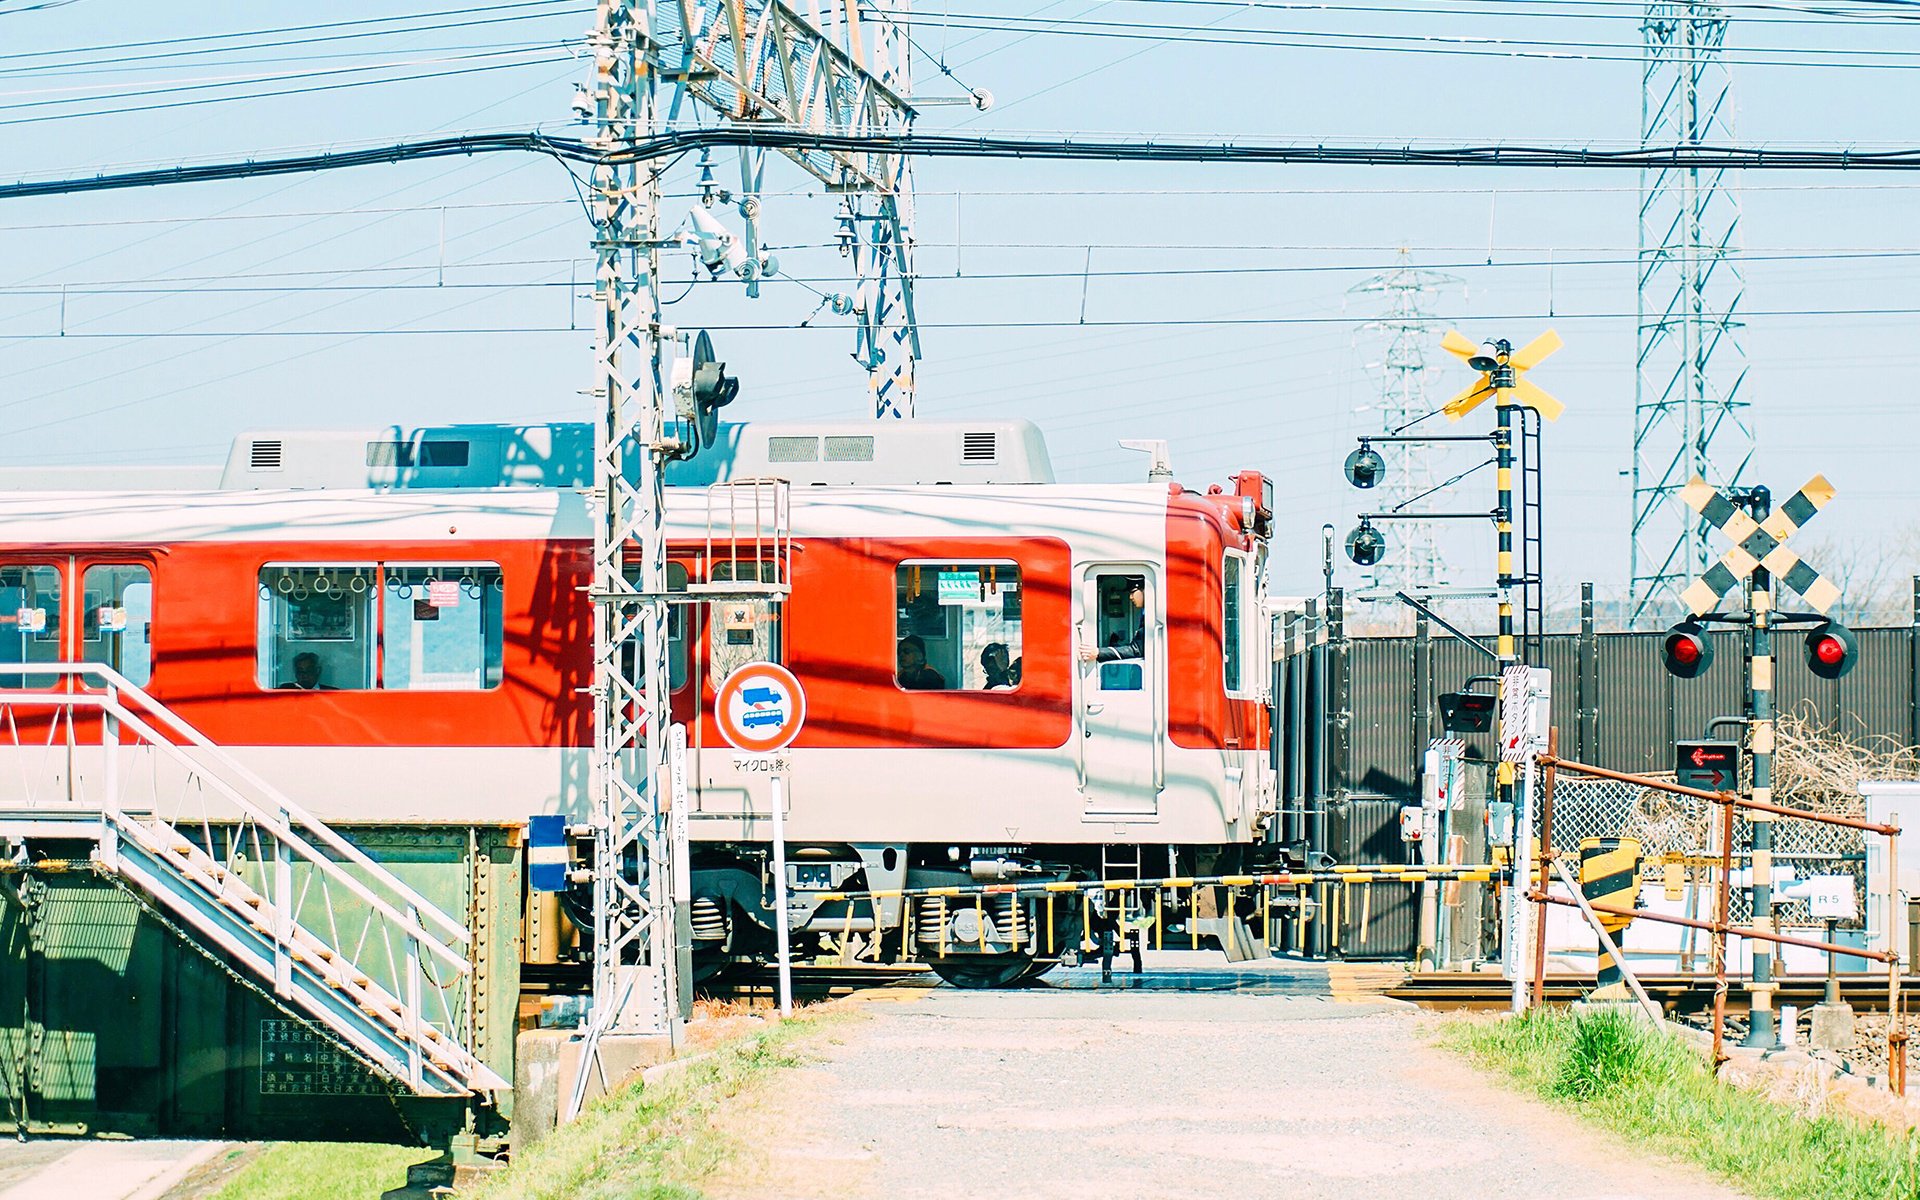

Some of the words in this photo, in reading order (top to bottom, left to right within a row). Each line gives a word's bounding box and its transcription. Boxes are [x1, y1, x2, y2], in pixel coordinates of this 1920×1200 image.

[733, 759, 791, 772] マイクロを除く
